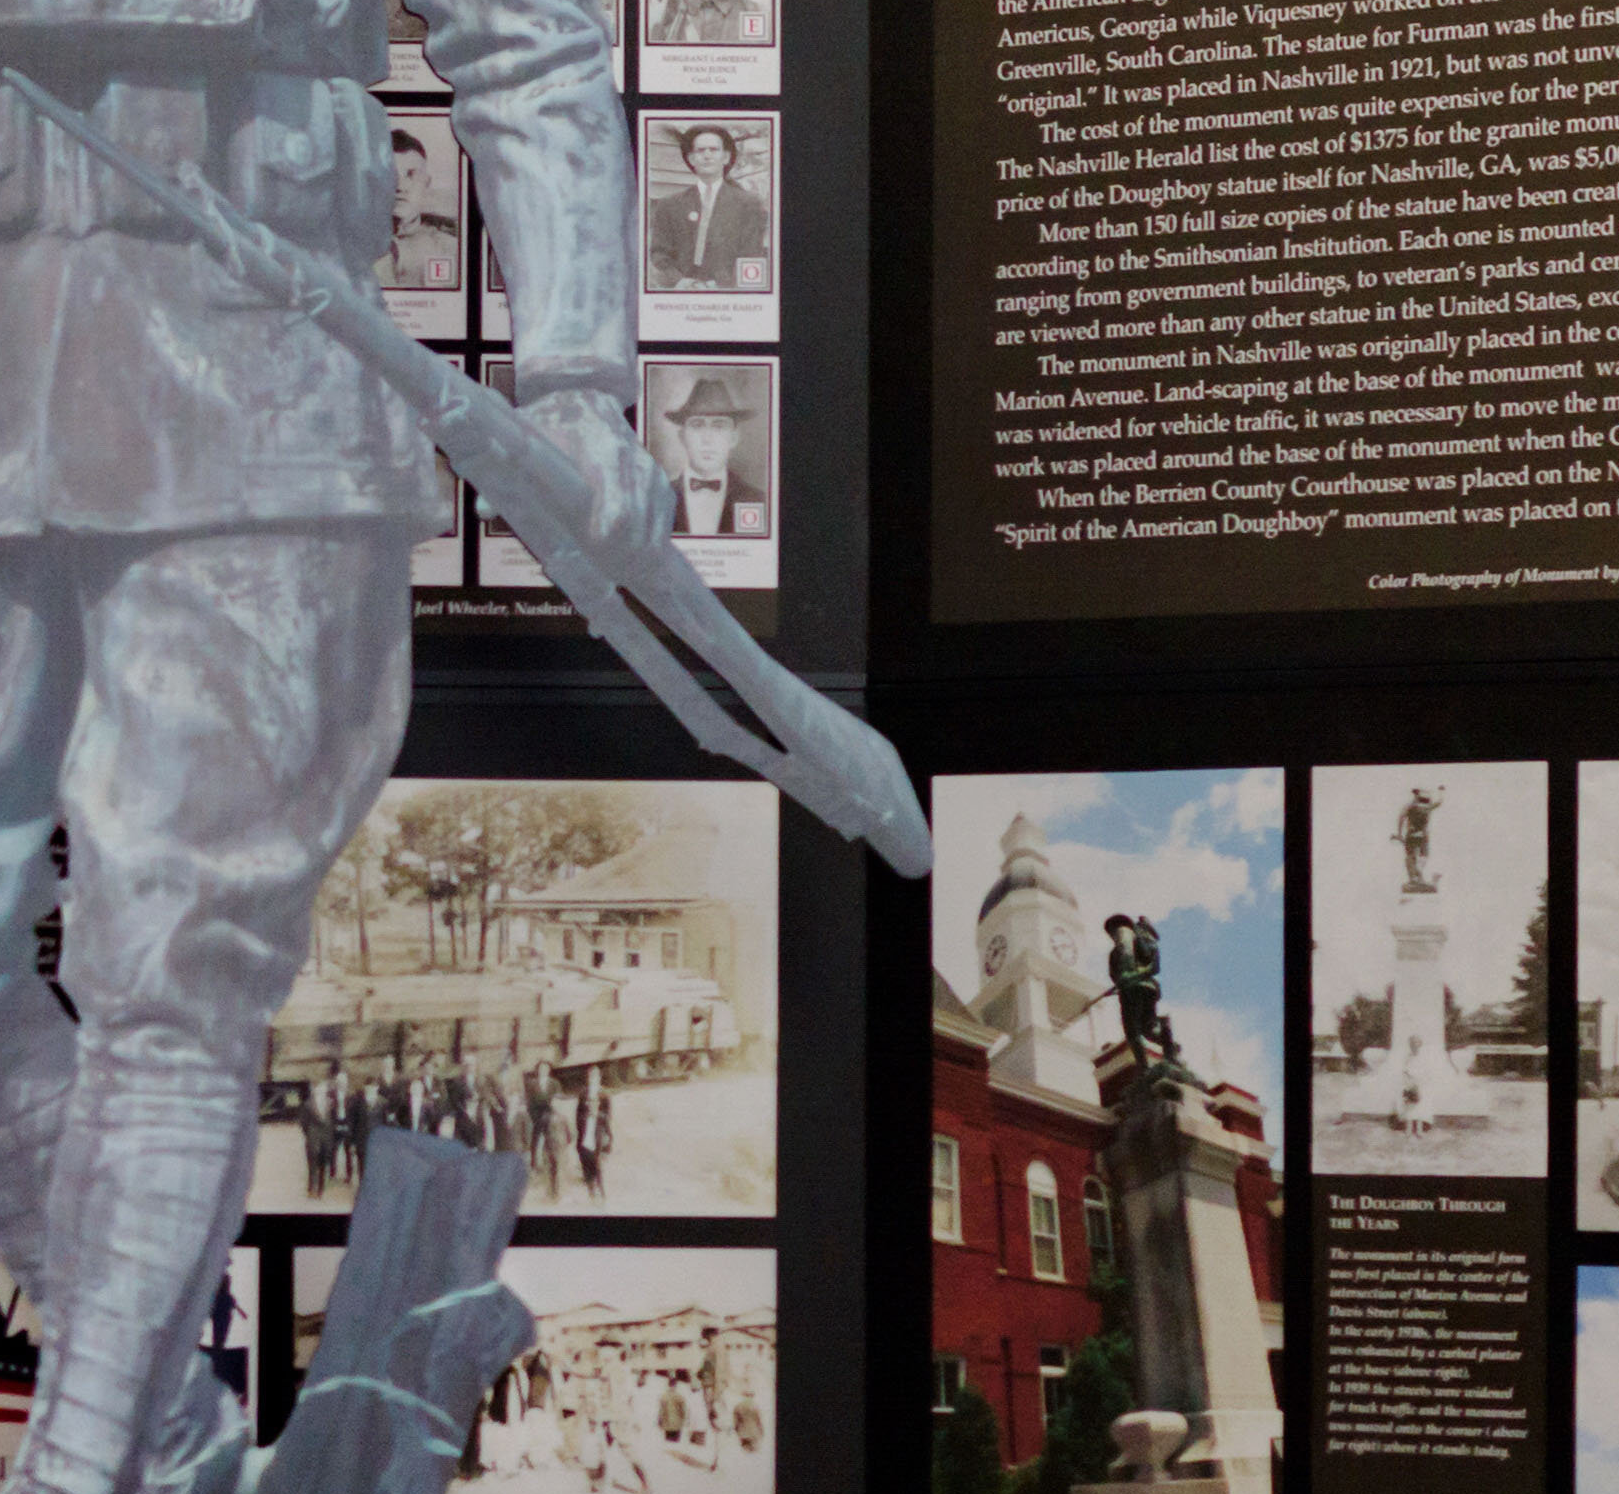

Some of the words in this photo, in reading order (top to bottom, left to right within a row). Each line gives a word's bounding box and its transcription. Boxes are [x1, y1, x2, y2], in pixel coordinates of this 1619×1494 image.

[993, 521, 1058, 549] "Spirit
[1059, 518, 1084, 542] of
[1084, 516, 1118, 541] the
[1120, 514, 1218, 539] American
[1221, 507, 1340, 539] Doughboy"
[1343, 504, 1458, 530] monument
[1460, 505, 1505, 524] was
[1507, 495, 1578, 529] placed
[1581, 500, 1612, 519] on
[1367, 572, 1409, 590] Color
[1409, 568, 1502, 591] Photography
[1503, 566, 1523, 587] of
[1521, 565, 1600, 583] Monument
